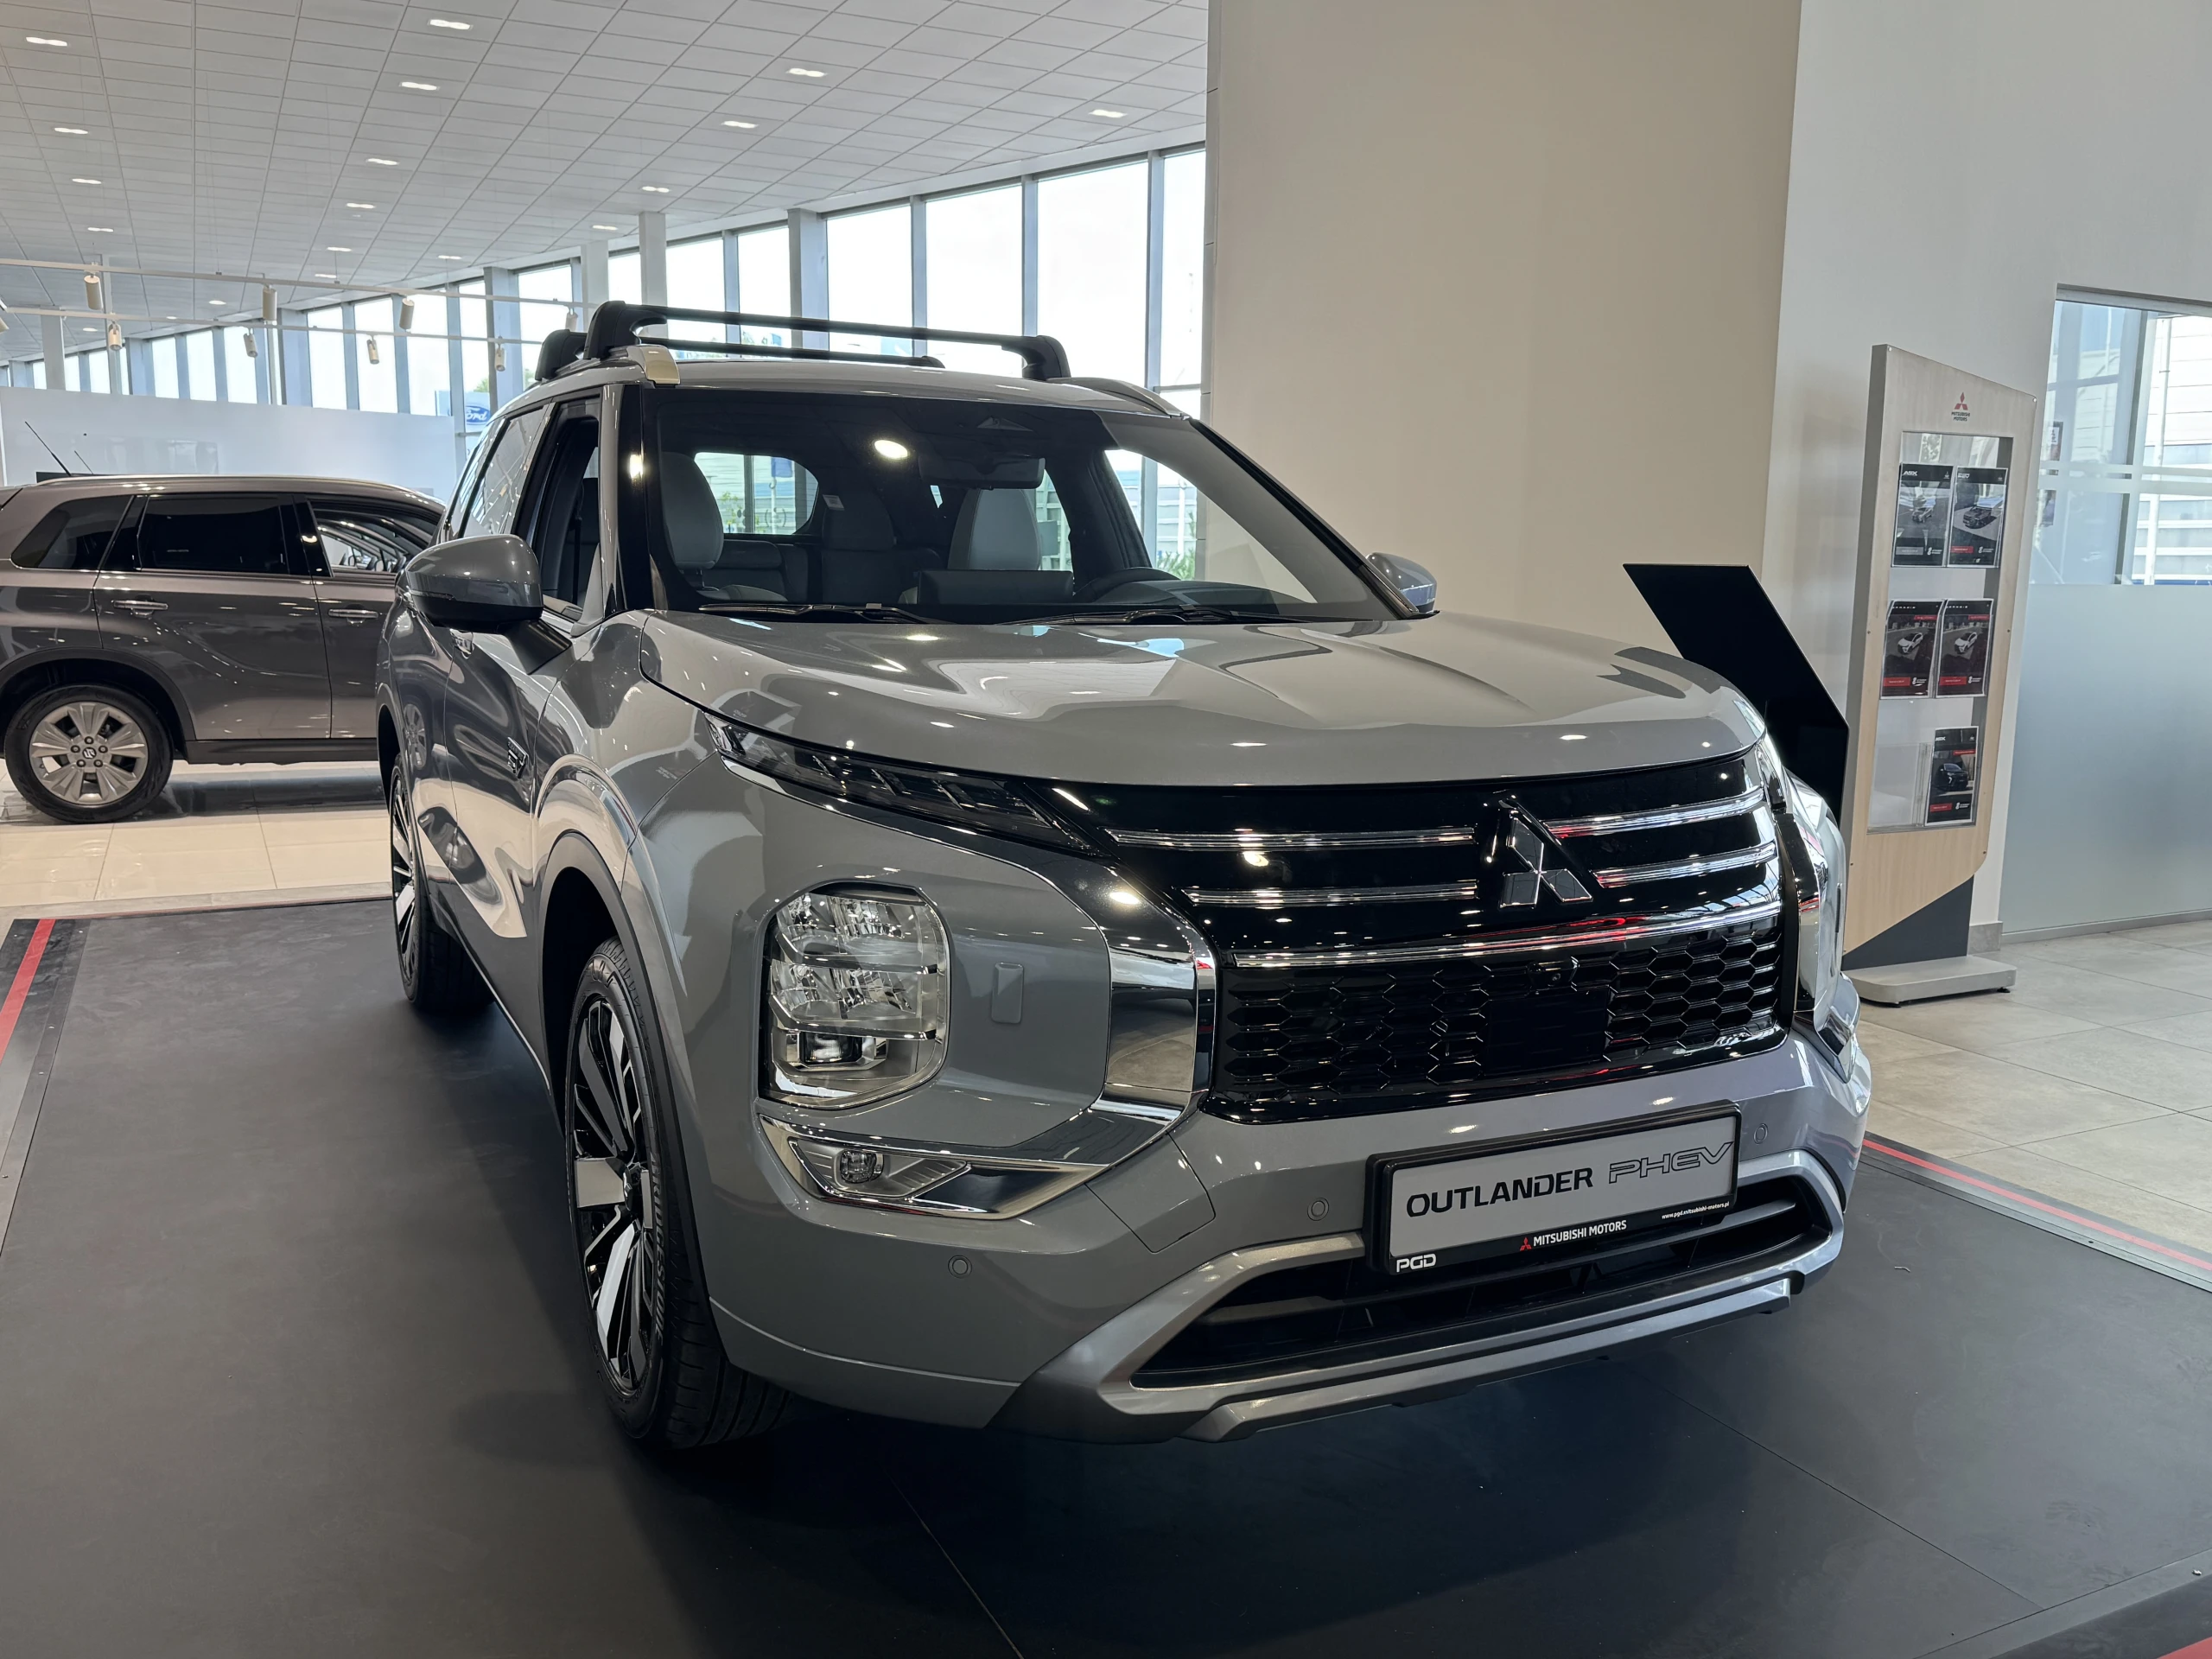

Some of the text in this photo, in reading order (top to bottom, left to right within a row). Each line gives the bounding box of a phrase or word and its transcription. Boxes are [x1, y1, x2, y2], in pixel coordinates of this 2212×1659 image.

[1406, 1141, 1733, 1217] OUTLANDER PHEV
[1533, 1219, 1627, 1247] MITSUBISHI MOTORS
[1396, 1253, 1436, 1273] PGD
